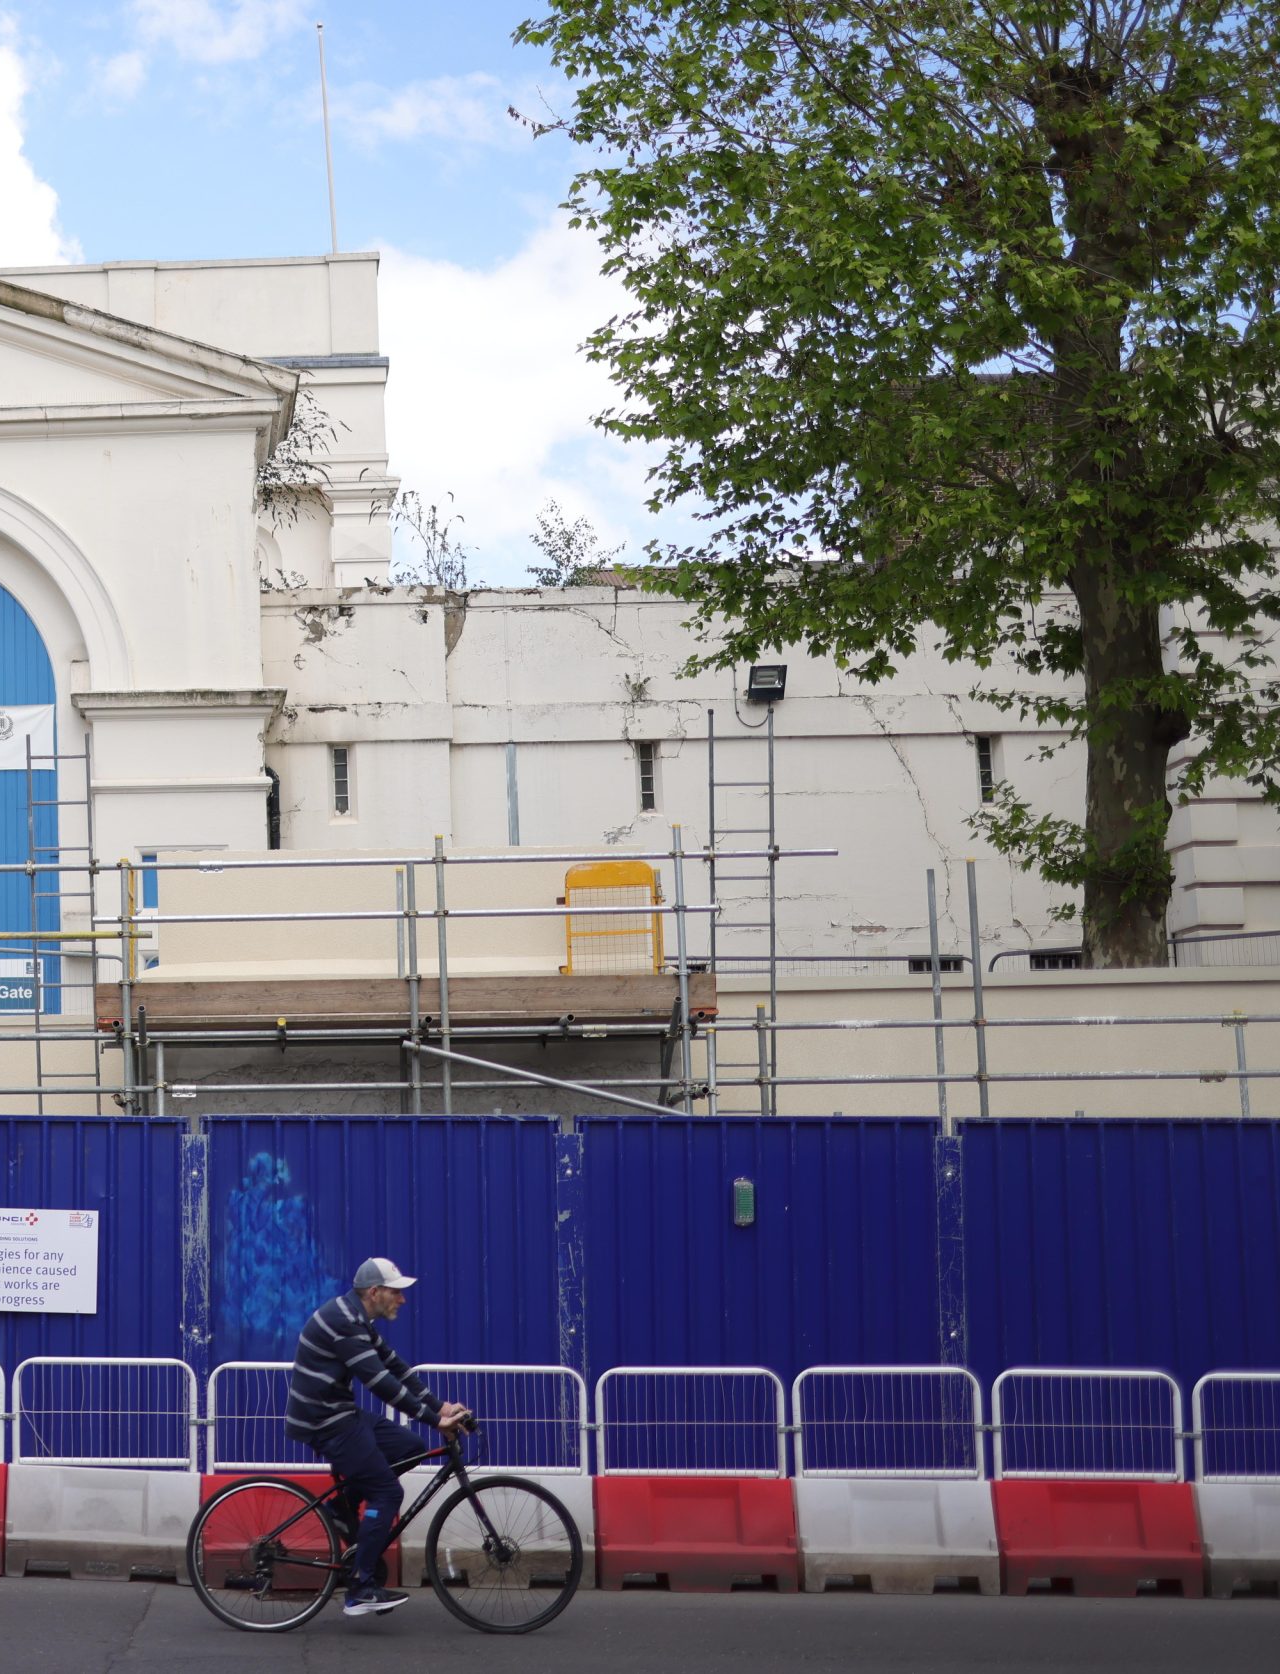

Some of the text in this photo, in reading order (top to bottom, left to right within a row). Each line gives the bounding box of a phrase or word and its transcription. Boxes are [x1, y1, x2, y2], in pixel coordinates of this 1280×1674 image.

[24, 1248, 39, 1260] for
[43, 1251, 64, 1263] any
[35, 1265, 77, 1276] caused
[4, 1278, 39, 1290] works
[42, 1282, 60, 1291] are
